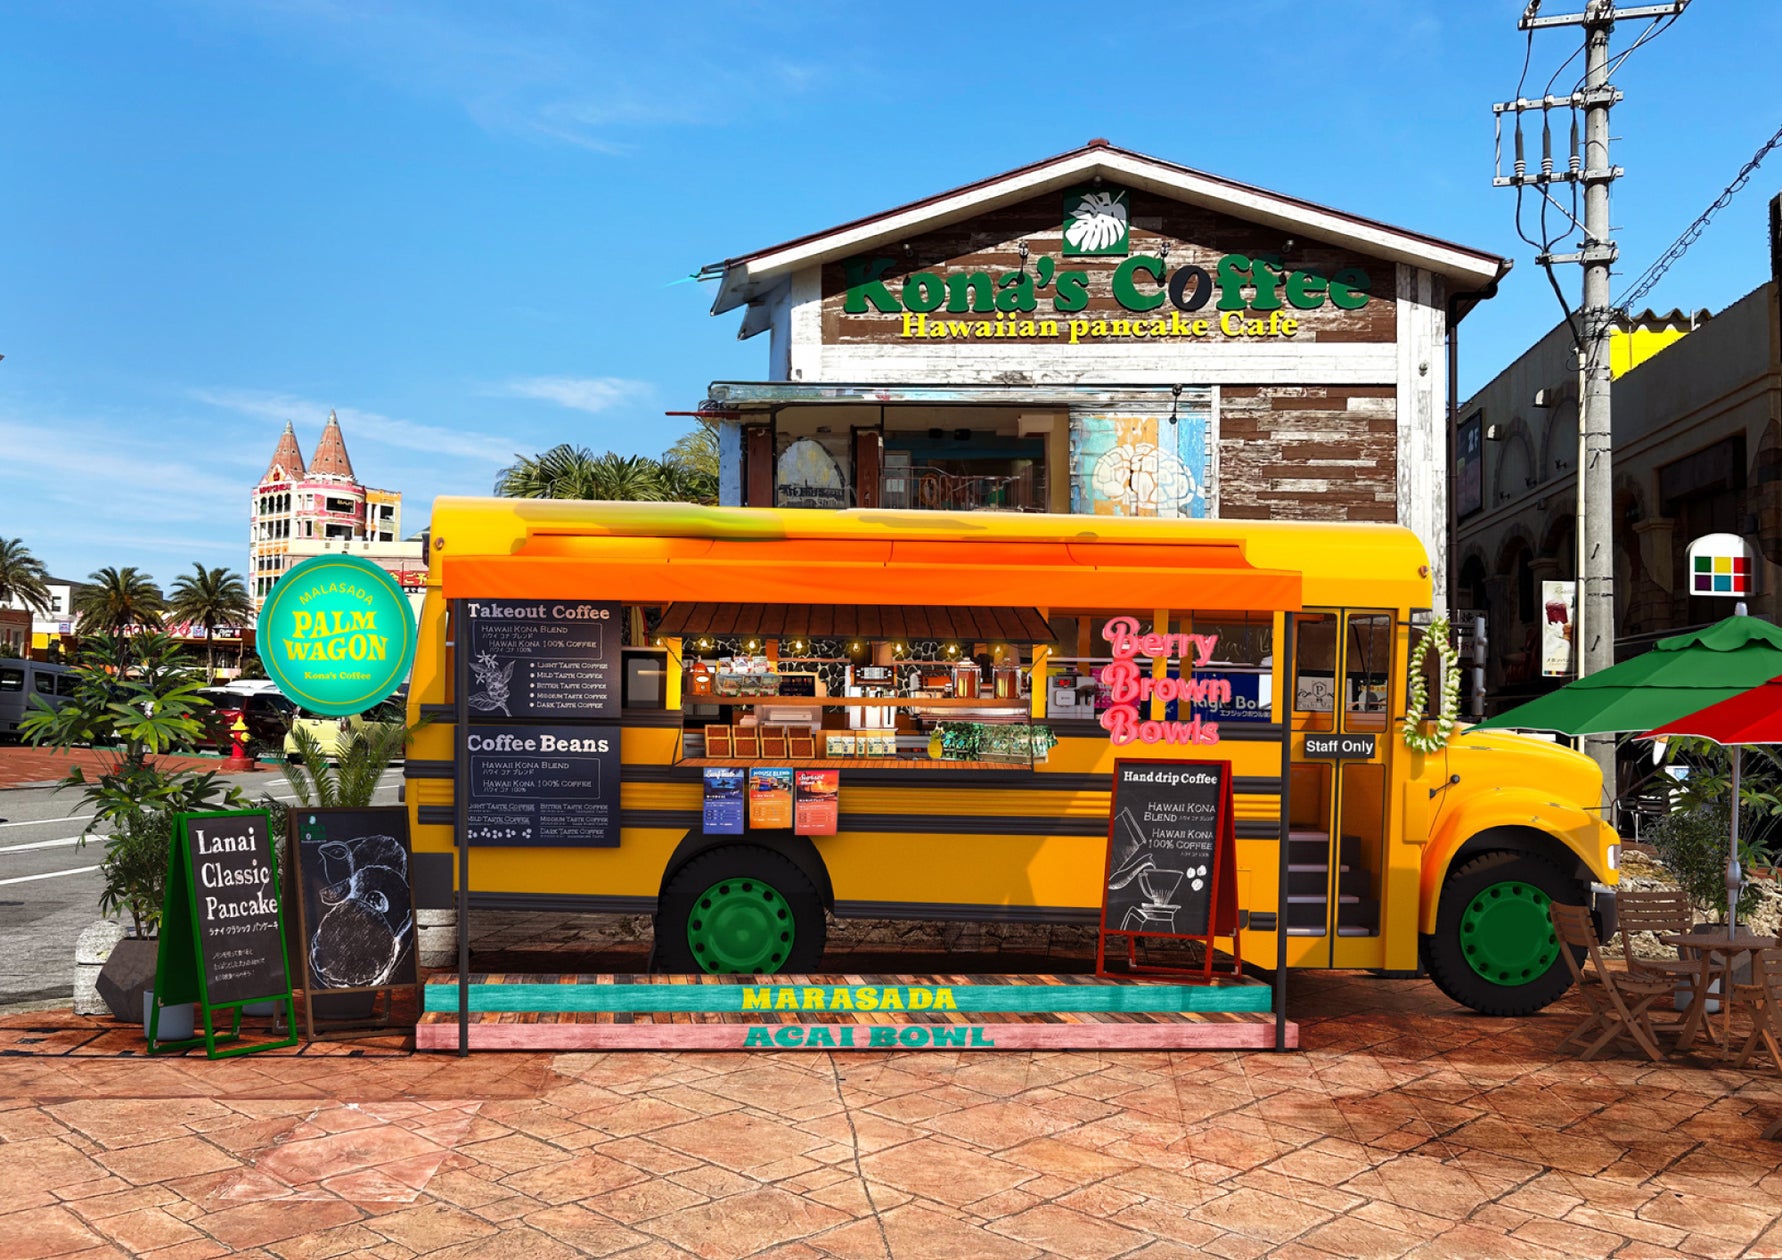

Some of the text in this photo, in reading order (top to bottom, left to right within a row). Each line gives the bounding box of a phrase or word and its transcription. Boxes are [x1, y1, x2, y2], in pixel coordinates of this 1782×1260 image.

[844, 254, 1372, 313] Kona's Coffee
[900, 310, 1298, 344] Hawaiian pancake Cafe
[299, 582, 373, 605] MALASADA
[468, 603, 611, 620] Takeout Coffee
[291, 610, 378, 639] PALM
[481, 625, 568, 634] HAWAII KONA BLEND
[282, 633, 389, 661] WAGON
[518, 640, 540, 648] KONA
[542, 640, 564, 648] 100%
[566, 640, 597, 649] COFFEE
[1102, 616, 1218, 667] Berry
[304, 672, 371, 680] Kona's Coffee
[1101, 660, 1231, 703] Brown
[1100, 704, 1220, 746] Bowls
[468, 734, 609, 752] Coffee Beans
[1306, 740, 1374, 755] Staff Only
[481, 761, 513, 769] HAWAII
[537, 780, 560, 788] 100%
[1124, 771, 1218, 786] Hand drip Coffee
[1143, 811, 1177, 822] BLEND
[1148, 802, 1216, 813] HAWAII KONA
[195, 827, 257, 855] Lanai
[1152, 828, 1214, 839] HAWAII KONA
[1148, 839, 1213, 850] 100% COFFEE
[201, 859, 270, 888] Classic
[205, 891, 278, 920] Pancake
[741, 987, 957, 1010] MARASADA
[743, 1026, 995, 1047] ACAI BOWL
